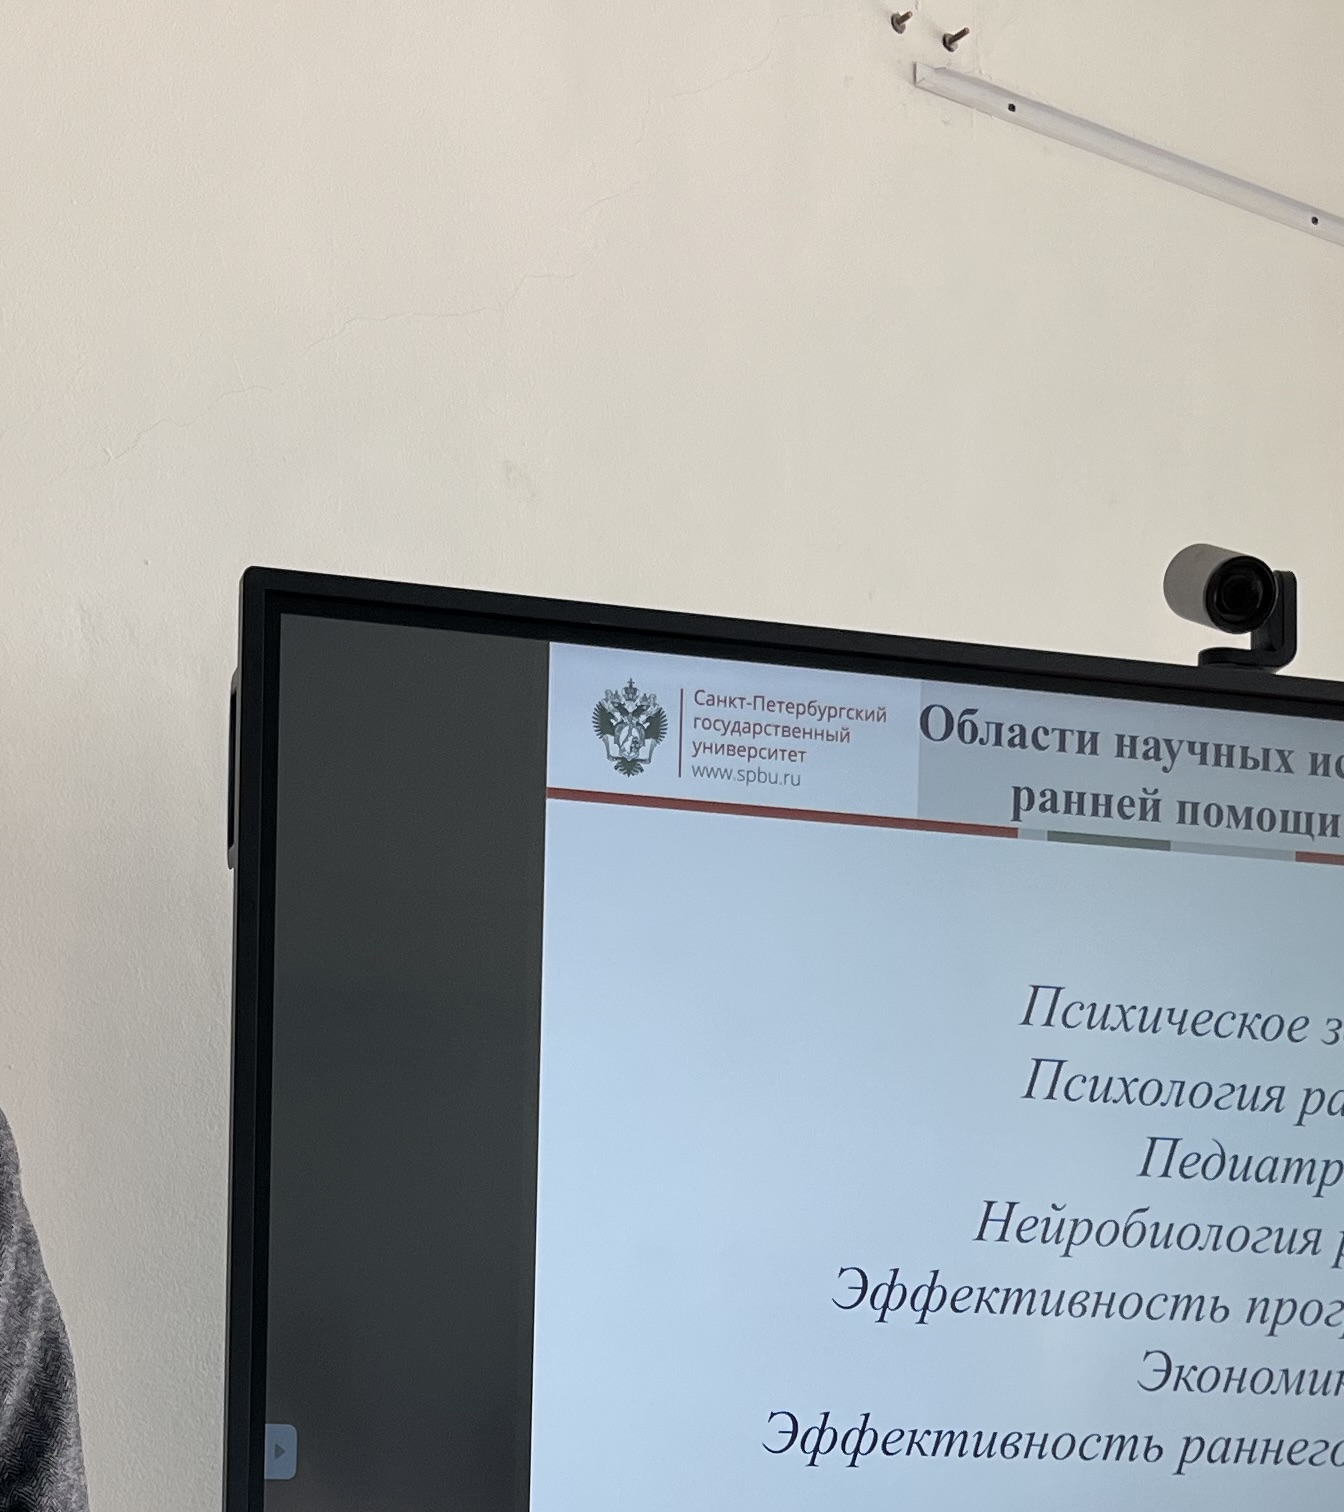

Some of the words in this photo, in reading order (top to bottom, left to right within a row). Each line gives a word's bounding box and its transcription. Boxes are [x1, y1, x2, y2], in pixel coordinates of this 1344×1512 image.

[692, 688, 888, 724] Санкт-Петербургский
[692, 714, 852, 744] государственный
[690, 738, 808, 764] университет
[918, 702, 1101, 756] Области
[1113, 730, 1297, 776] научных
[690, 763, 802, 788] www.spbu.ru
[1009, 785, 1164, 824] ранней
[1175, 799, 1343, 844] помощи
[1018, 984, 1309, 1043] Психическое
[1020, 1058, 1286, 1113] Психология
[972, 1200, 1322, 1258] Нейробиология
[831, 1266, 1230, 1325] Эффективность
[762, 1411, 1164, 1468] Эффективность
